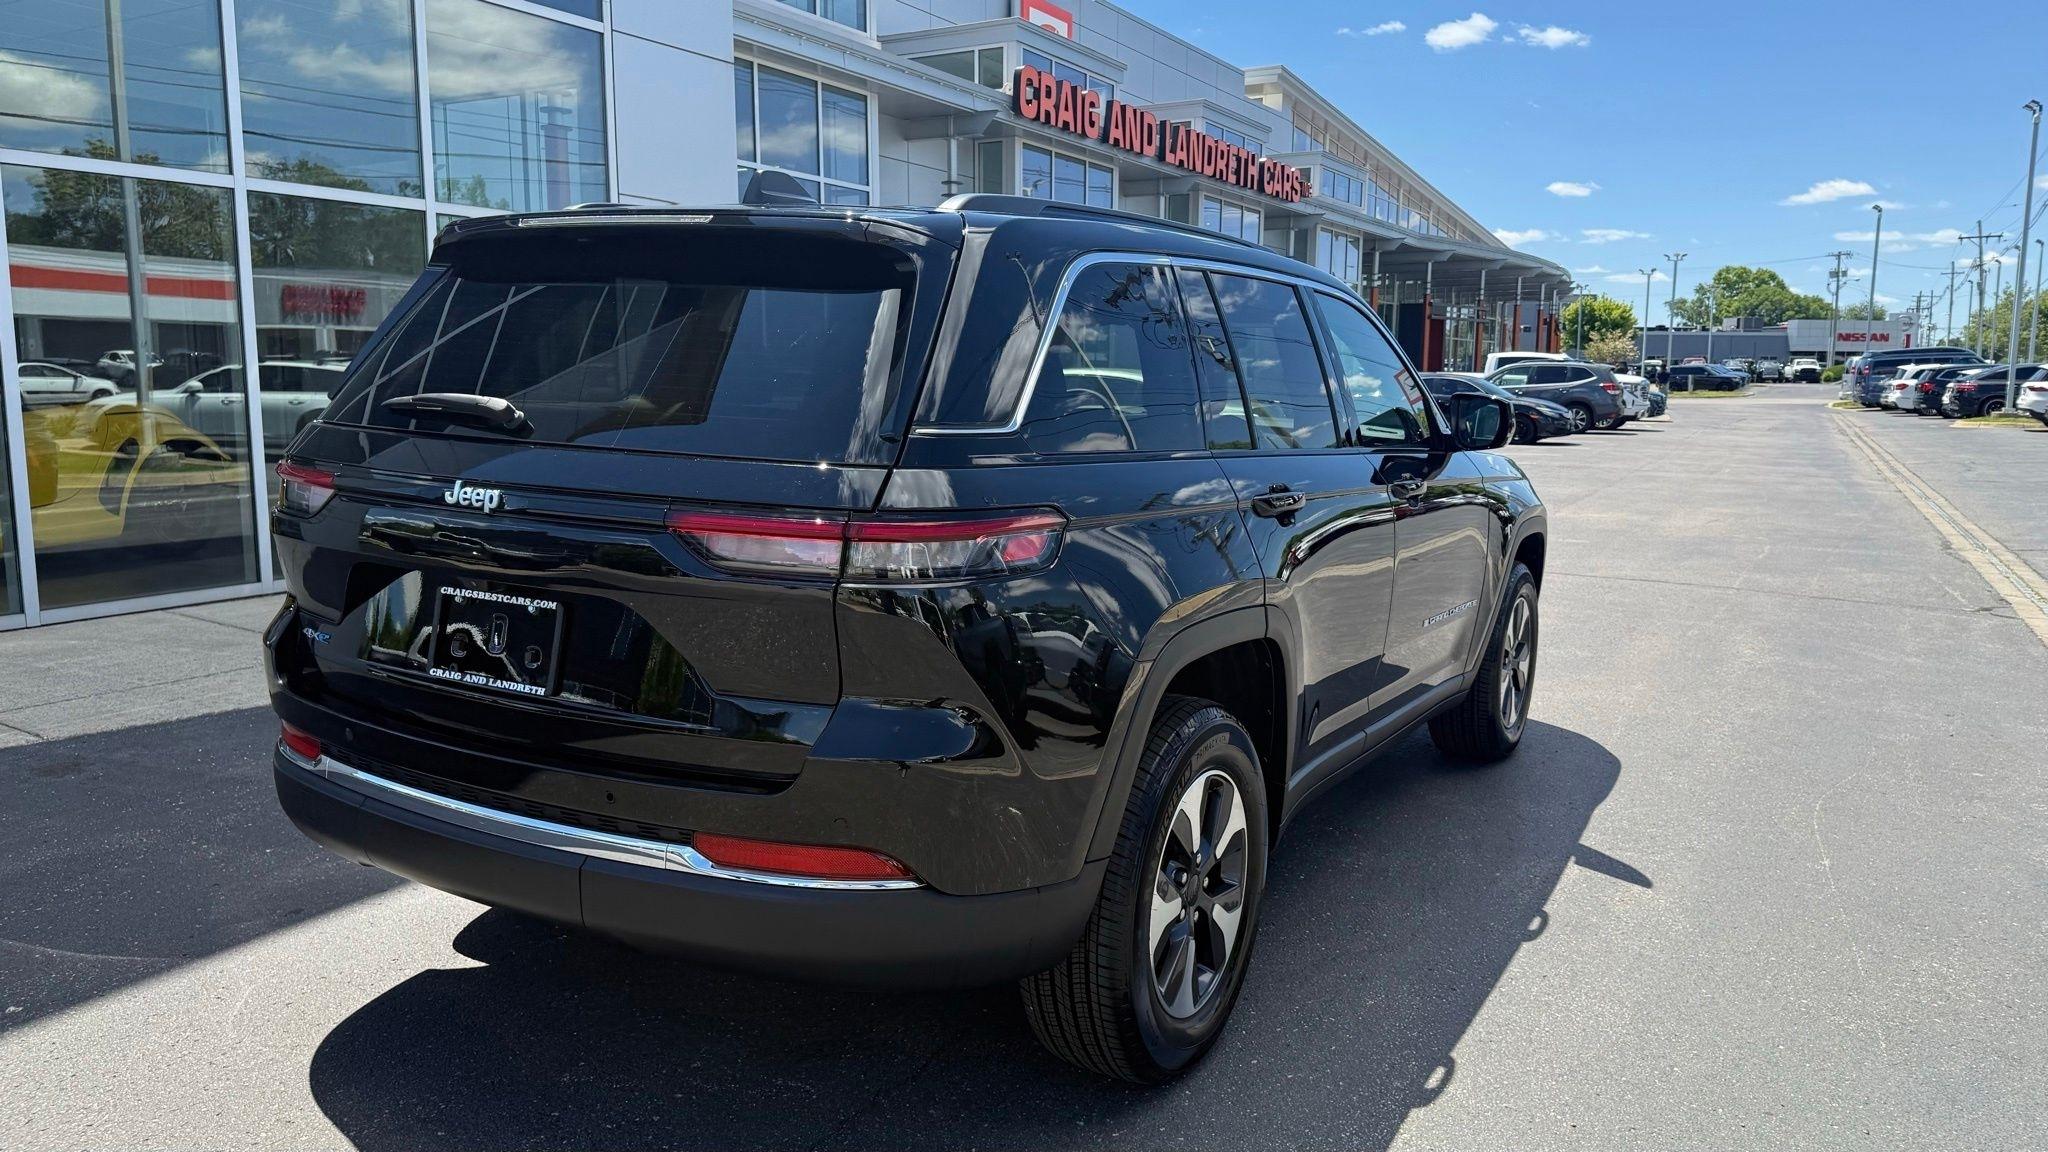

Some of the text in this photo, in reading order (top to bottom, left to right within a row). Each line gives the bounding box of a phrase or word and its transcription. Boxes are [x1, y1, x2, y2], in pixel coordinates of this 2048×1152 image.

[1014, 64, 1101, 140] CRAIG
[1105, 99, 1158, 157] AND
[1160, 119, 1258, 191] LANDRETH
[1261, 157, 1301, 203] CARS
[1837, 332, 1890, 342] NISSAN
[444, 480, 501, 513] Jeep
[440, 586, 558, 610] CRAIGSBESTCARS.COM
[429, 668, 546, 696] CRAIG AND LANDRETH
